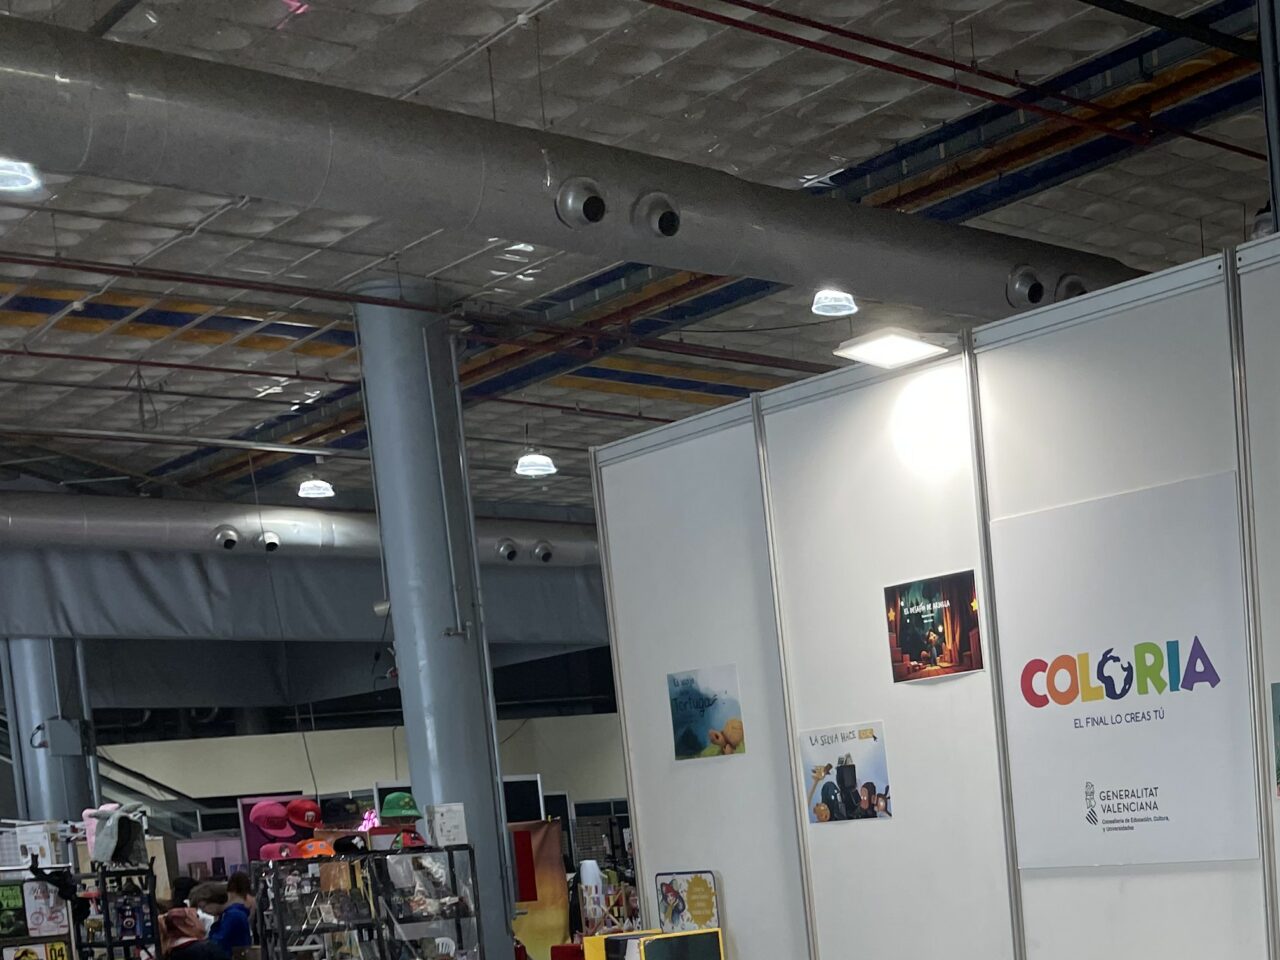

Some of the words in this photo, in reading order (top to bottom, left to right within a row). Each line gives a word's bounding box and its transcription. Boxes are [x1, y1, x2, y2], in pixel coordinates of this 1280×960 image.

[1020, 635, 1221, 708] COLORIA
[1074, 718, 1084, 729] EL
[1086, 716, 1109, 728] FINAL
[1111, 714, 1122, 725] LO
[1124, 711, 1151, 723] CREAS
[1153, 706, 1165, 720] TÚ
[809, 736, 818, 746] LA
[820, 733, 838, 746] SELVA
[1100, 786, 1159, 801] GENERALITAT
[1100, 800, 1159, 814] VALENCIANA
